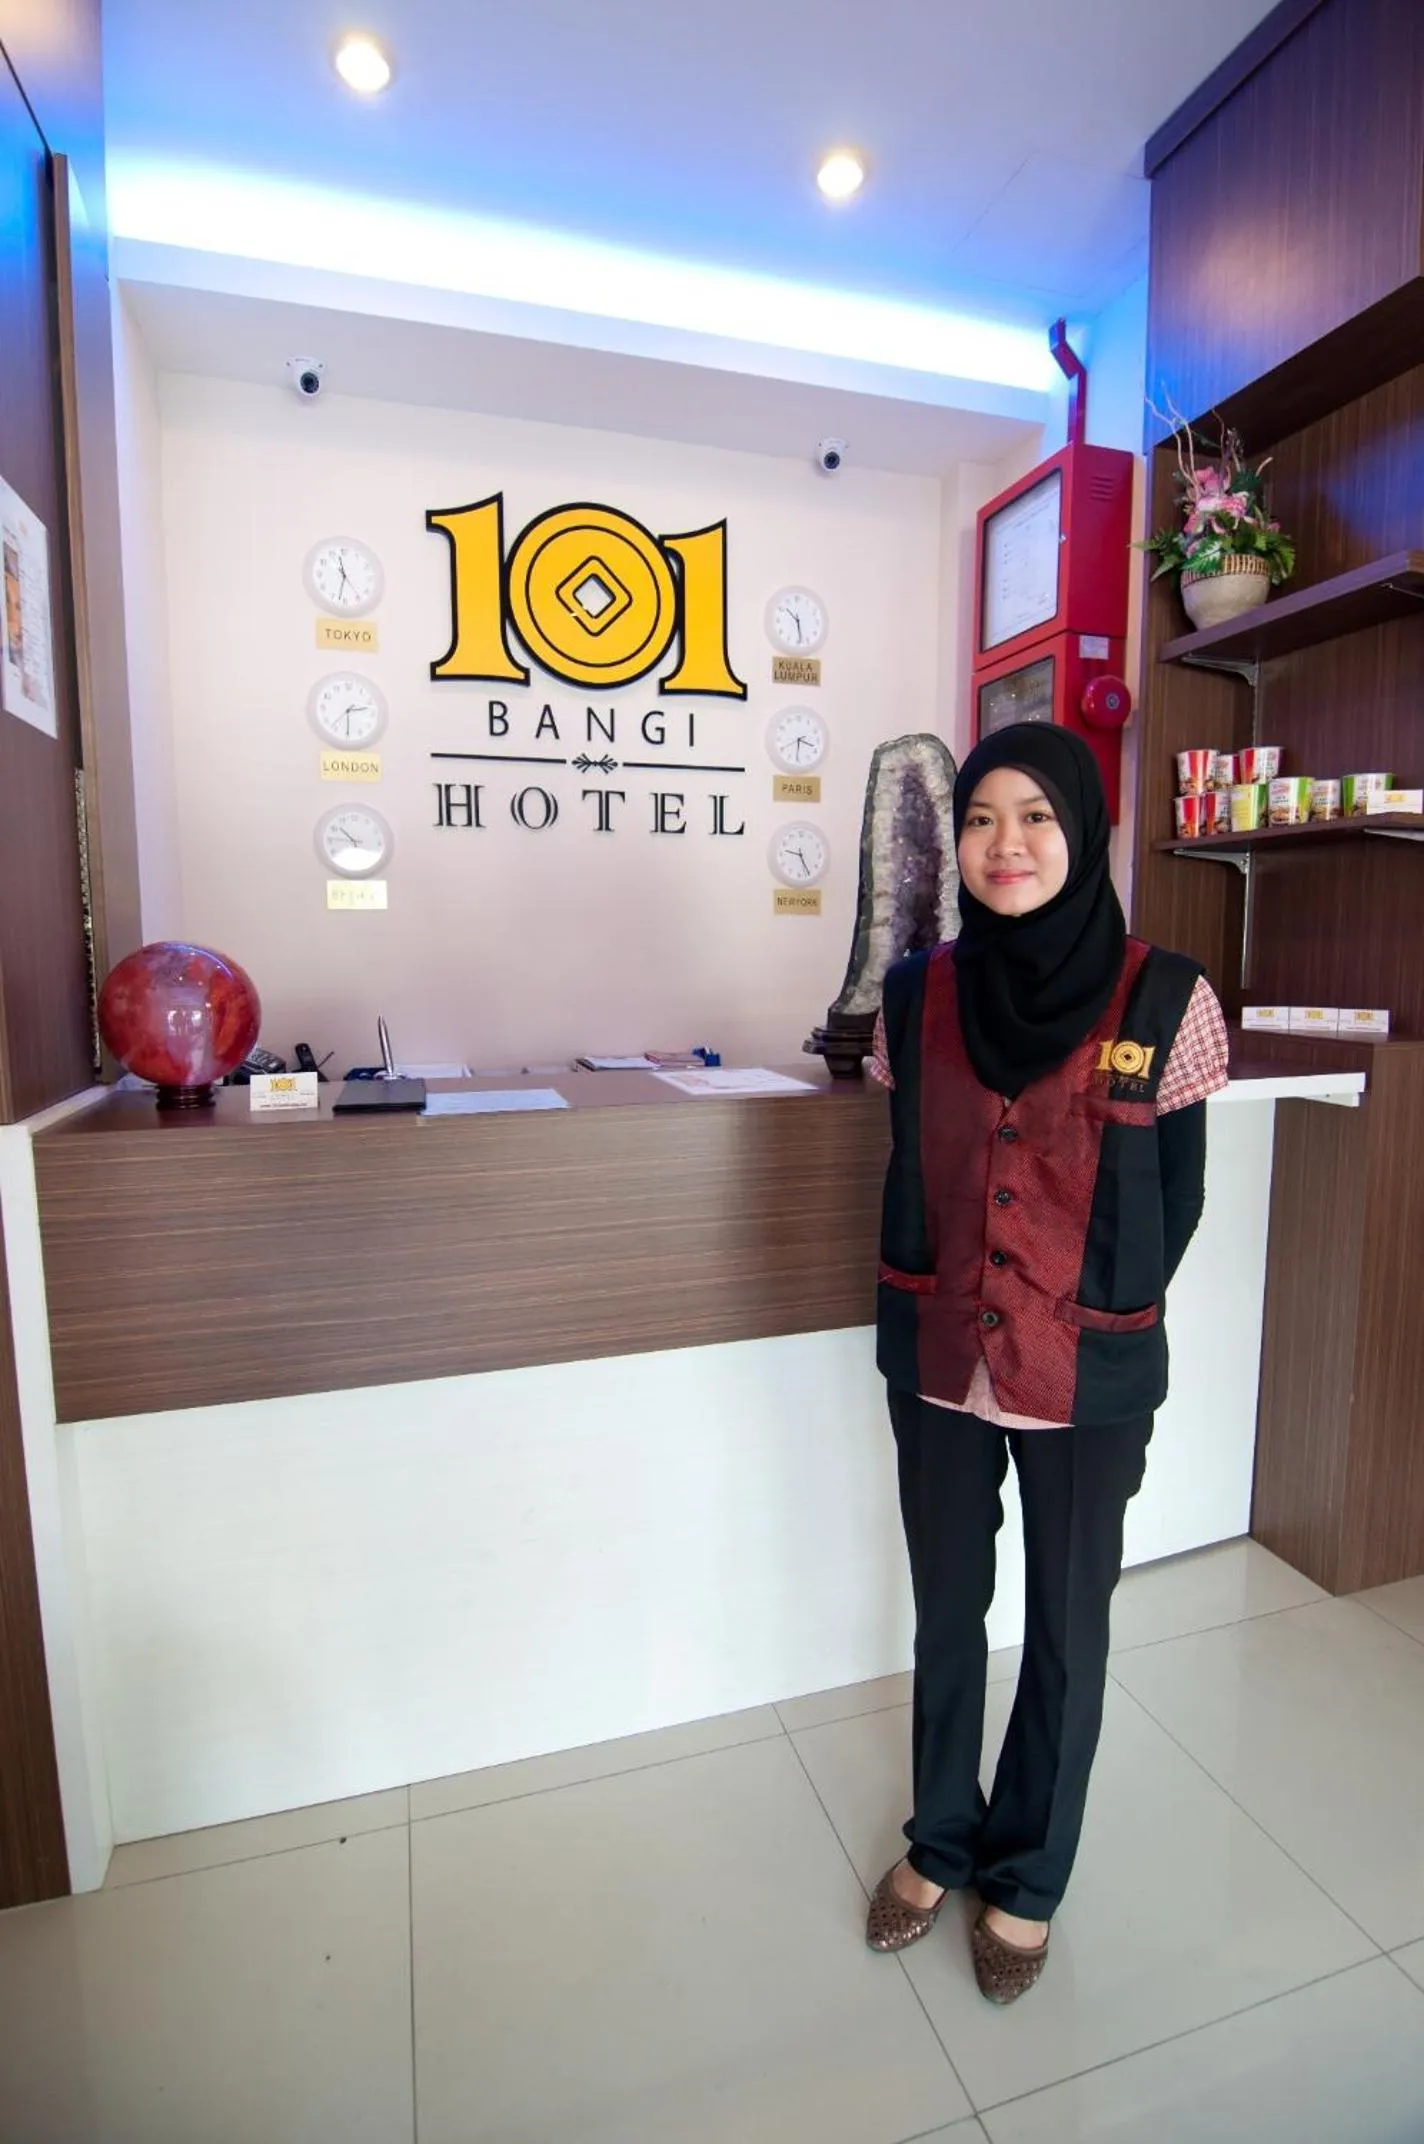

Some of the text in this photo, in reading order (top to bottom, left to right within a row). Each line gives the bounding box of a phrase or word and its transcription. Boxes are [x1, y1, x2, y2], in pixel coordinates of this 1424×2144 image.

[425, 490, 748, 701] 101
[325, 627, 372, 642] TOKYO
[778, 660, 813, 672] KUALA
[488, 699, 695, 747] BANGI
[323, 760, 379, 773] LONDON
[782, 783, 813, 795] PARIS
[432, 782, 746, 836] HOTEL
[1094, 1040, 1156, 1079] 101
